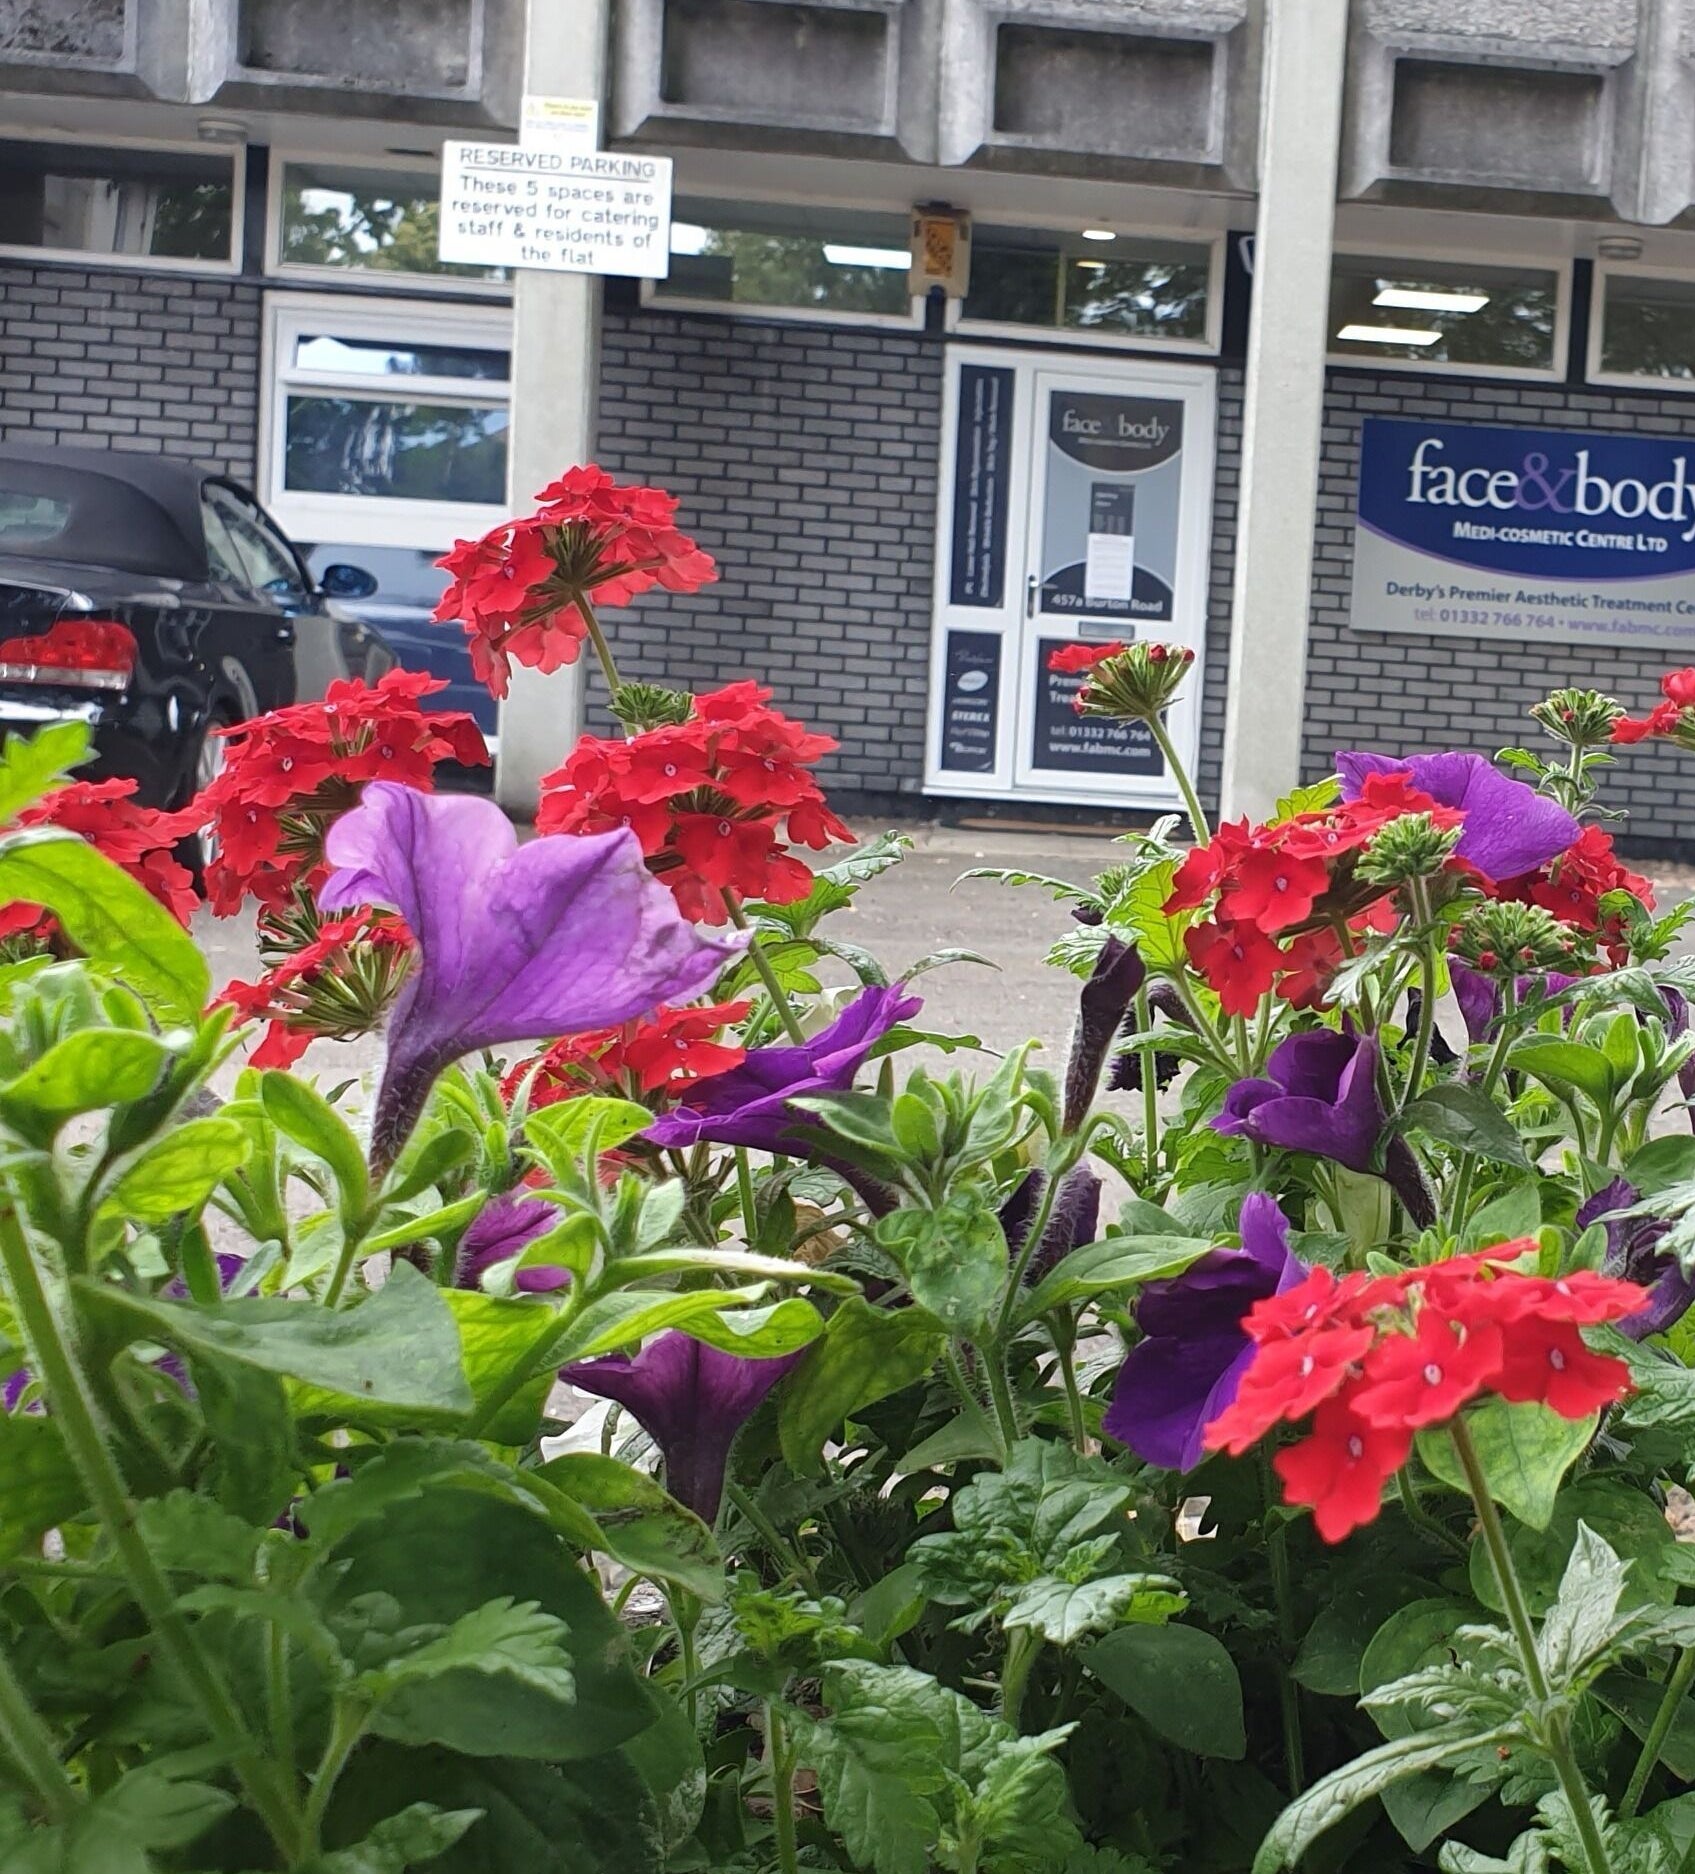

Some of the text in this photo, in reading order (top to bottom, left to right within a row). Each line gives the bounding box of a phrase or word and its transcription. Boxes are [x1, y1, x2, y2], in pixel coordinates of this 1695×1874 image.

[460, 148, 656, 179] RESERVED PARKING
[461, 175, 653, 206] These 5 spaces are
[452, 201, 659, 231] reserved for catering
[458, 221, 652, 249] staff & residents of
[522, 246, 594, 266] the flat
[1118, 413, 1170, 447] body
[1131, 599, 1163, 613] Road
[1386, 581, 1446, 601] Derby's
[1449, 586, 1511, 604] Premier
[1515, 590, 1589, 608] Aesthetic
[1592, 594, 1672, 614] Treatment
[1439, 608, 1489, 626] 01332
[1493, 612, 1522, 627] 766
[1526, 613, 1556, 629] 764
